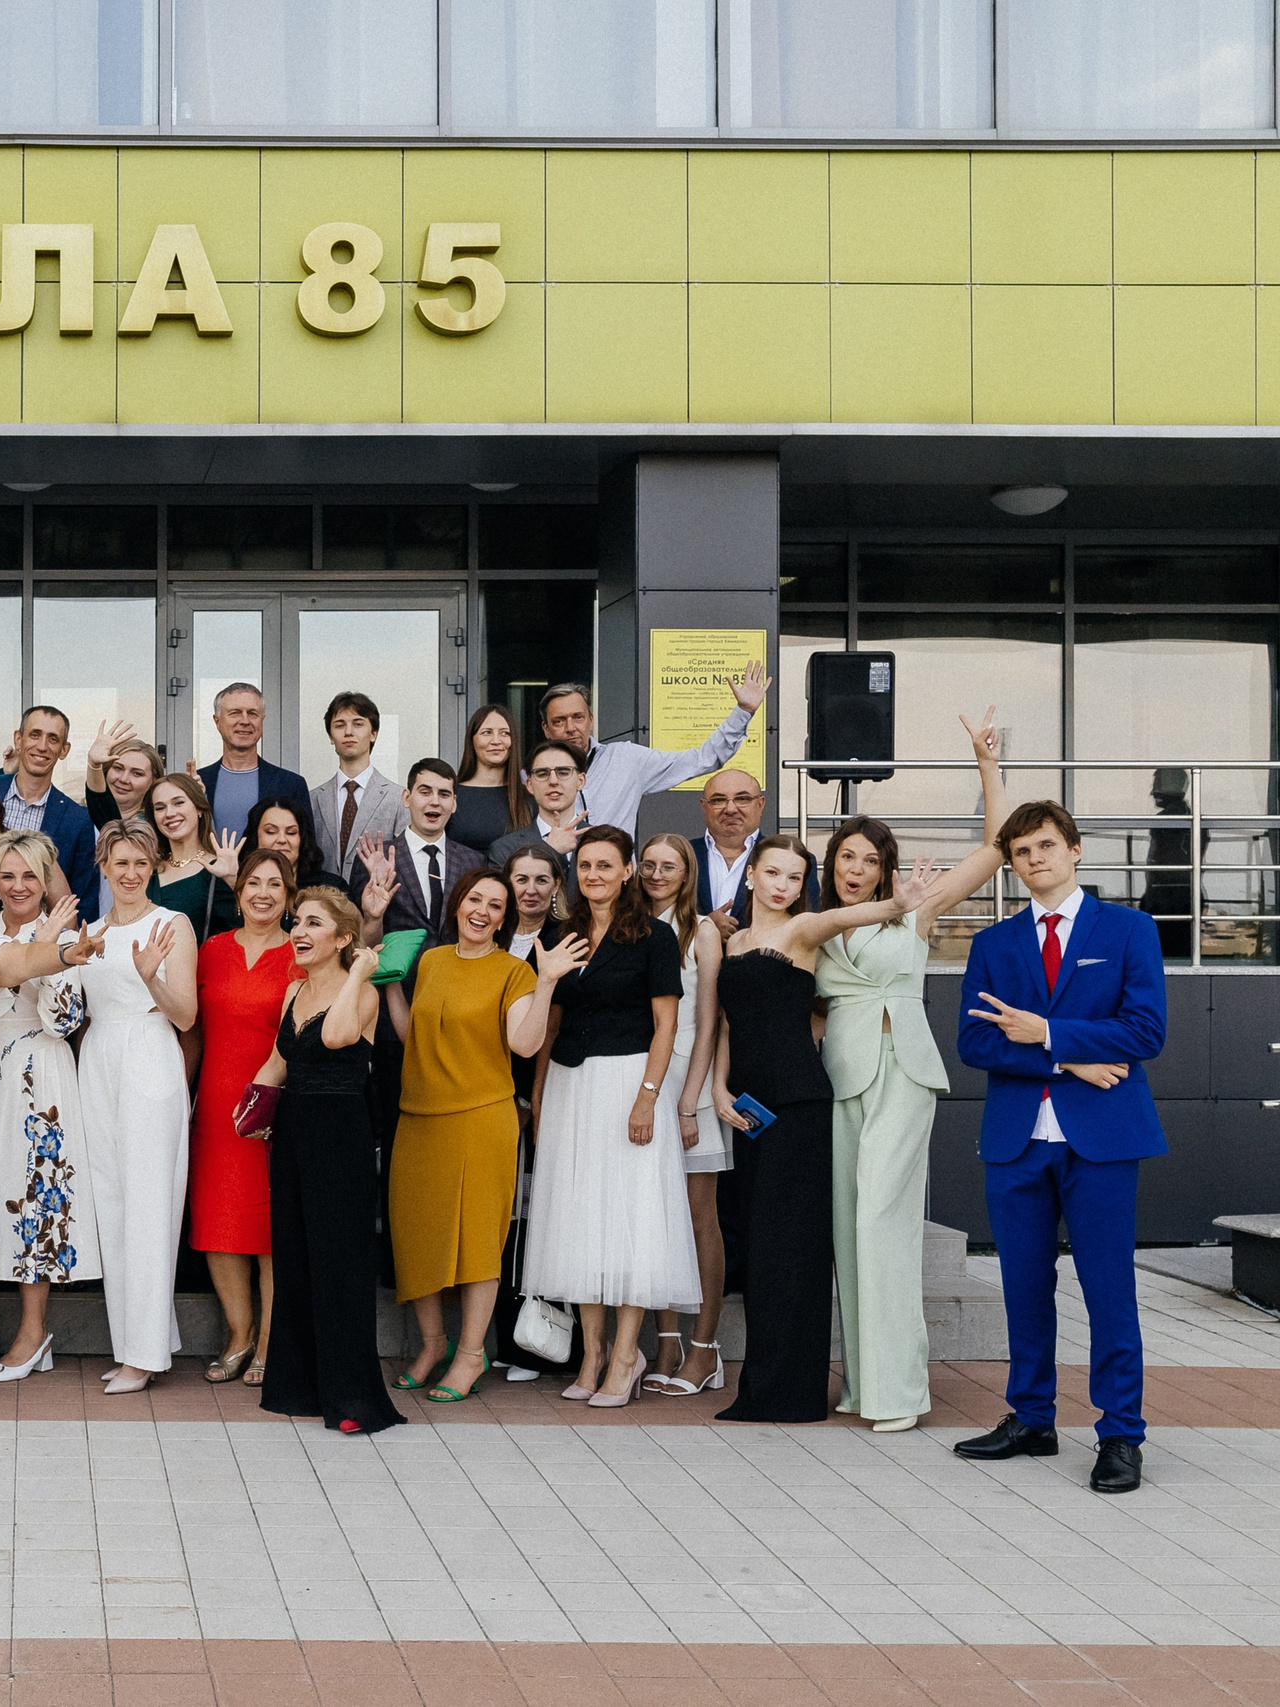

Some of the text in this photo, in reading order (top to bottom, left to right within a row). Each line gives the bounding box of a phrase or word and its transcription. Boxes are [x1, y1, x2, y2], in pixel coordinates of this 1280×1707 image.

[294, 221, 506, 337] 85
[688, 658, 725, 666] «Средняя
[661, 676, 707, 685] школа
